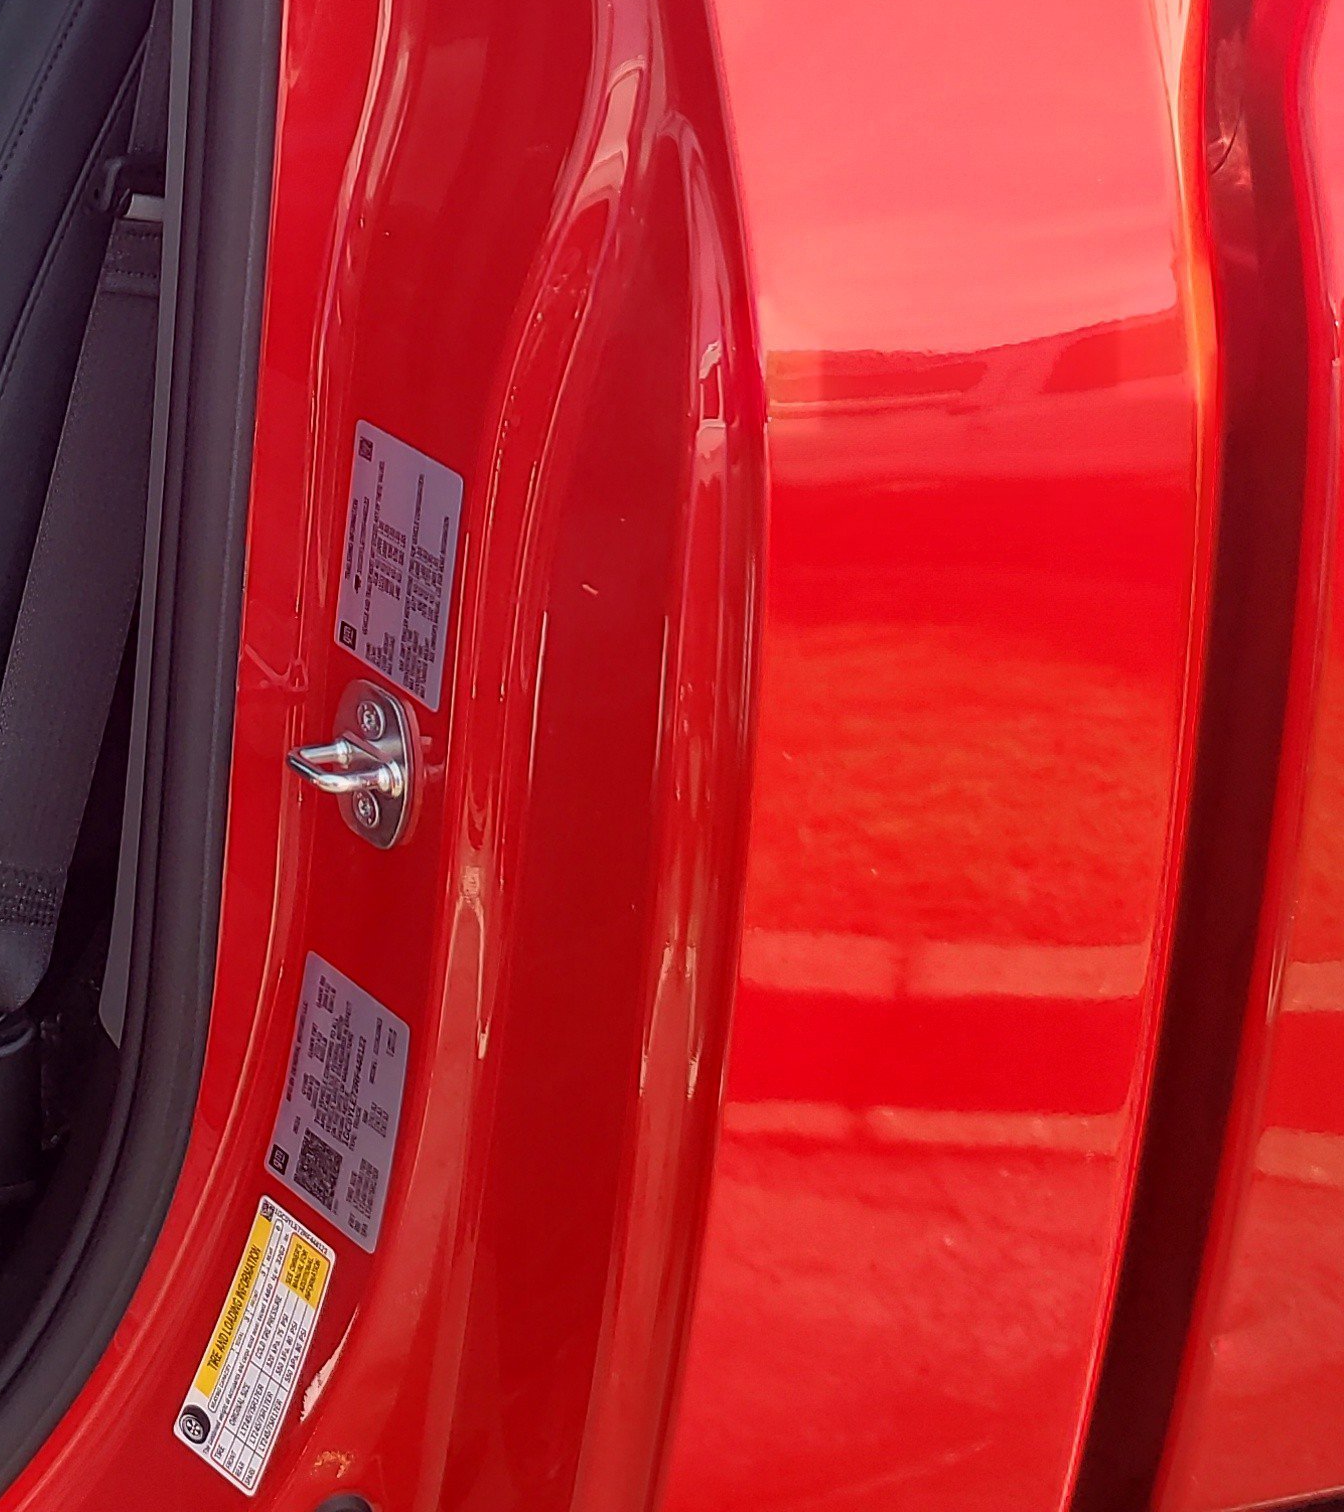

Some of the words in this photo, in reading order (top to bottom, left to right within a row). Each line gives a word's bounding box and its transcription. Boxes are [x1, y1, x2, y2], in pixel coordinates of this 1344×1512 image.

[233, 1242, 262, 1301] INFORMATION
[220, 1294, 243, 1337] LOADING
[206, 1347, 223, 1373] TIRE
[213, 1329, 230, 1354] AND
[227, 1394, 245, 1428] ORIGINAL
[253, 1338, 267, 1361] COLD
[264, 1292, 283, 1329] PRESSURE
